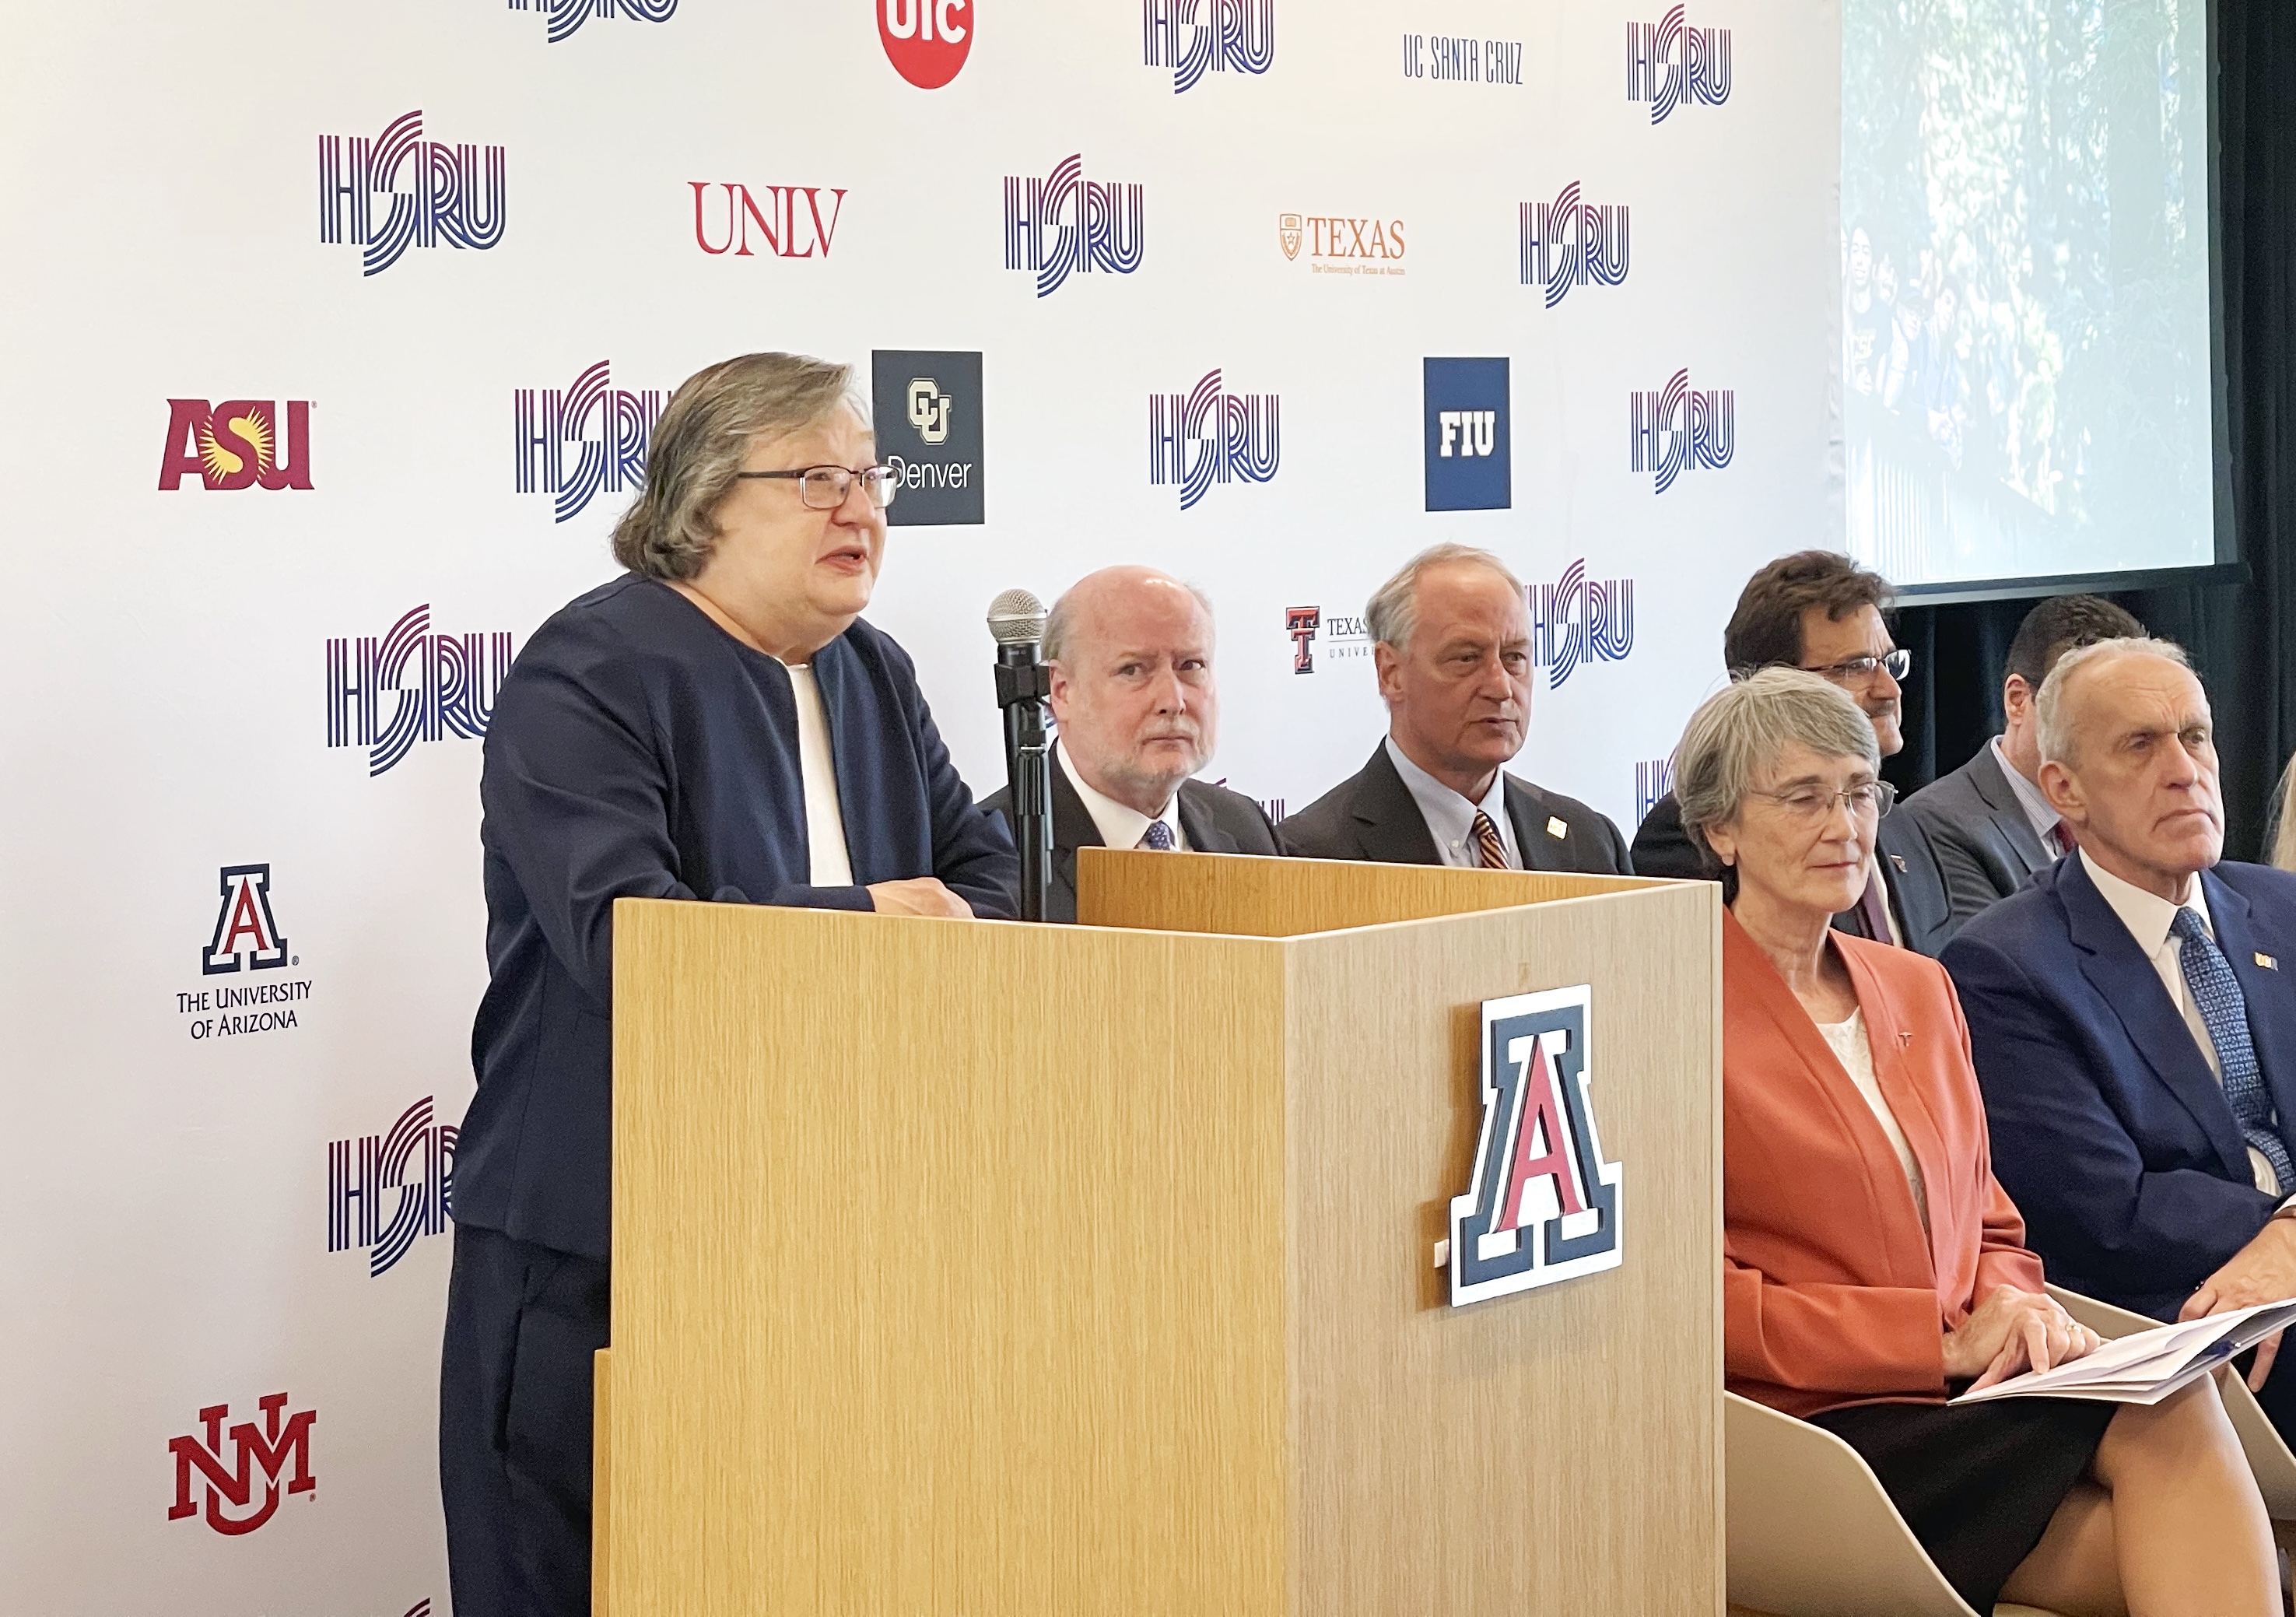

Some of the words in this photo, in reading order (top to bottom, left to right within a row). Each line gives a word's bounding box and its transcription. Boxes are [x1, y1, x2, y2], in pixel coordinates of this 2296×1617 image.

[887, 0, 966, 44] UIC
[1404, 34, 1423, 78] UC
[1432, 36, 1478, 82] SANTA
[1486, 40, 1523, 85] CRUZ
[1627, 4, 1732, 125] HSRU
[319, 110, 506, 277] HSRU
[688, 182, 848, 258] UNLV
[1004, 154, 1144, 299] HSRU
[1307, 217, 1405, 259] TEXAS
[1311, 264, 1322, 273] The
[1323, 264, 1353, 276] University
[1354, 265, 1361, 274] of
[1362, 265, 1379, 275] Texas
[1520, 181, 1630, 309] HSRU
[158, 398, 315, 490] ASU
[515, 360, 671, 524] HSR
[907, 377, 952, 445] CU
[1150, 369, 1281, 510] HSRU
[1439, 410, 1495, 458] FIU
[1632, 368, 1734, 495] HSRU
[888, 455, 973, 489] Denver
[203, 863, 288, 975] A
[176, 992, 210, 1013] THE
[216, 980, 312, 1009] UNIVERSITY
[191, 1019, 213, 1040] OF
[217, 1009, 298, 1036] ARIZONA
[329, 1095, 461, 1278] HSR
[1460, 1003, 1617, 1289] A
